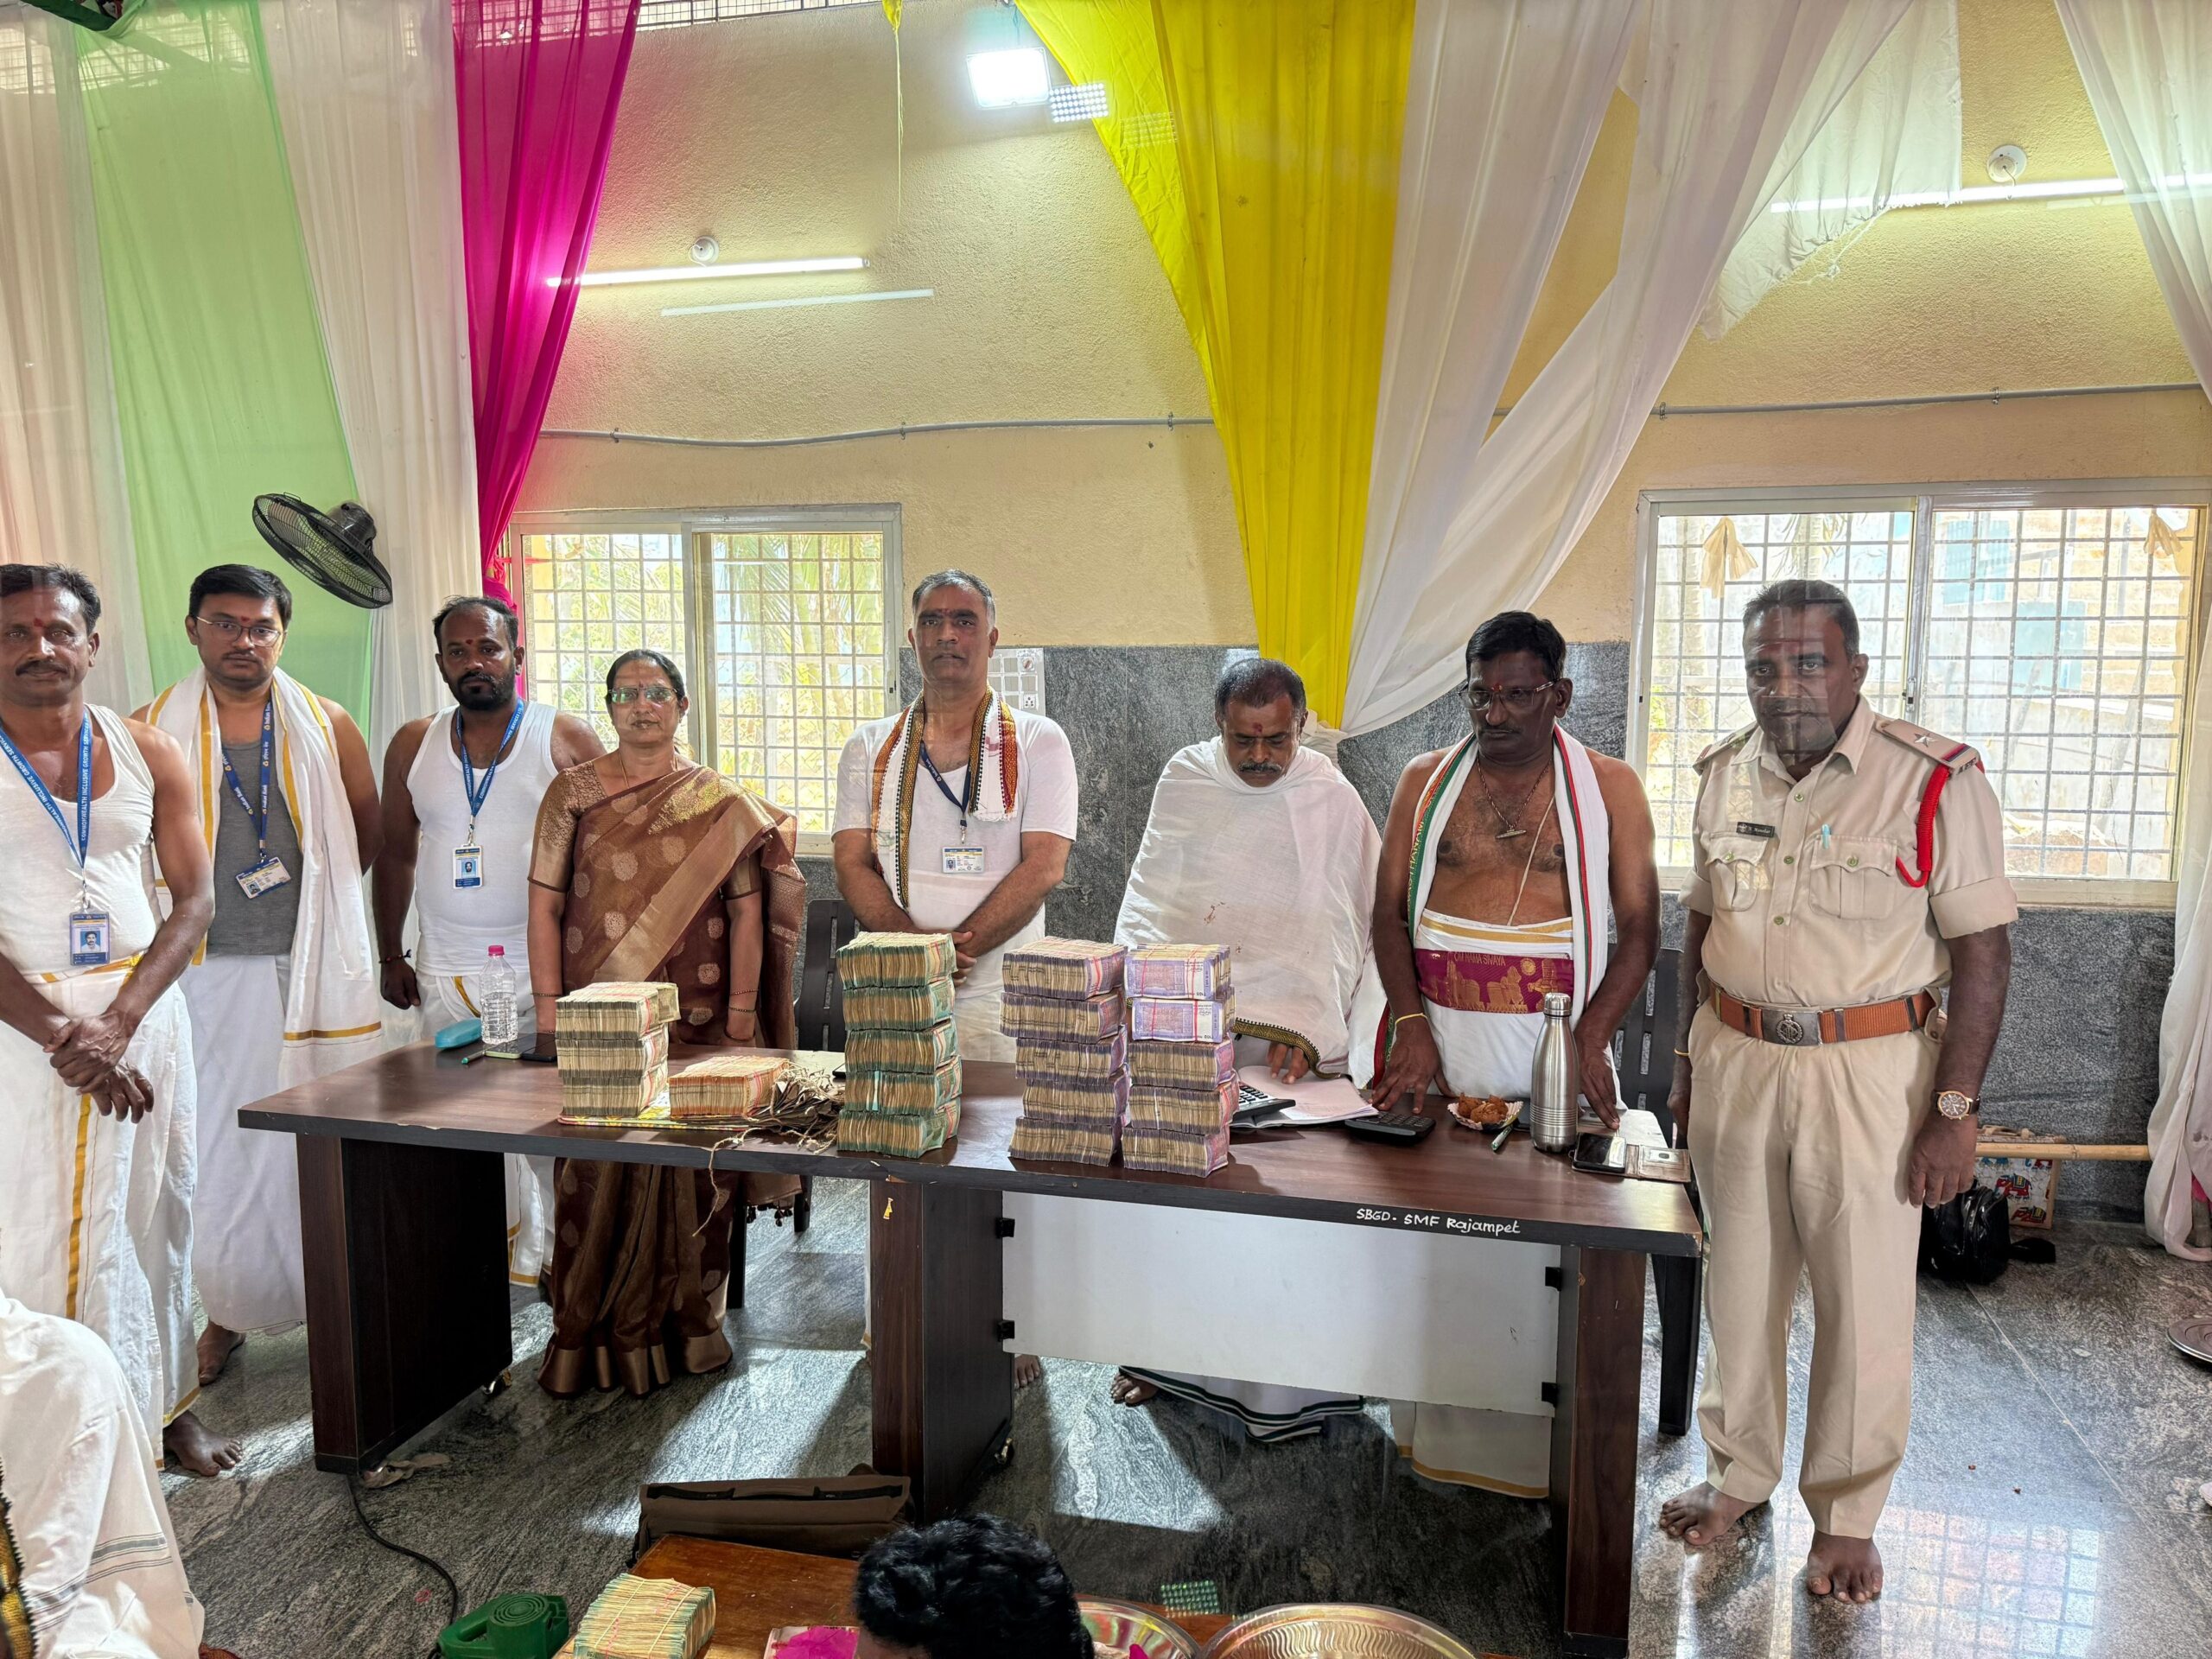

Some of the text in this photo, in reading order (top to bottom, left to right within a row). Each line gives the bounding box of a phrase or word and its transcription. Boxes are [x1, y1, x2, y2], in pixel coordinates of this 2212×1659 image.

[11, 754, 30, 777] GROWTH
[27, 774, 48, 803] INCLUSIVE
[80, 795, 89, 842] COMMONWEALTH
[1357, 1208, 1521, 1236] SBGD. SMF Rajampet
